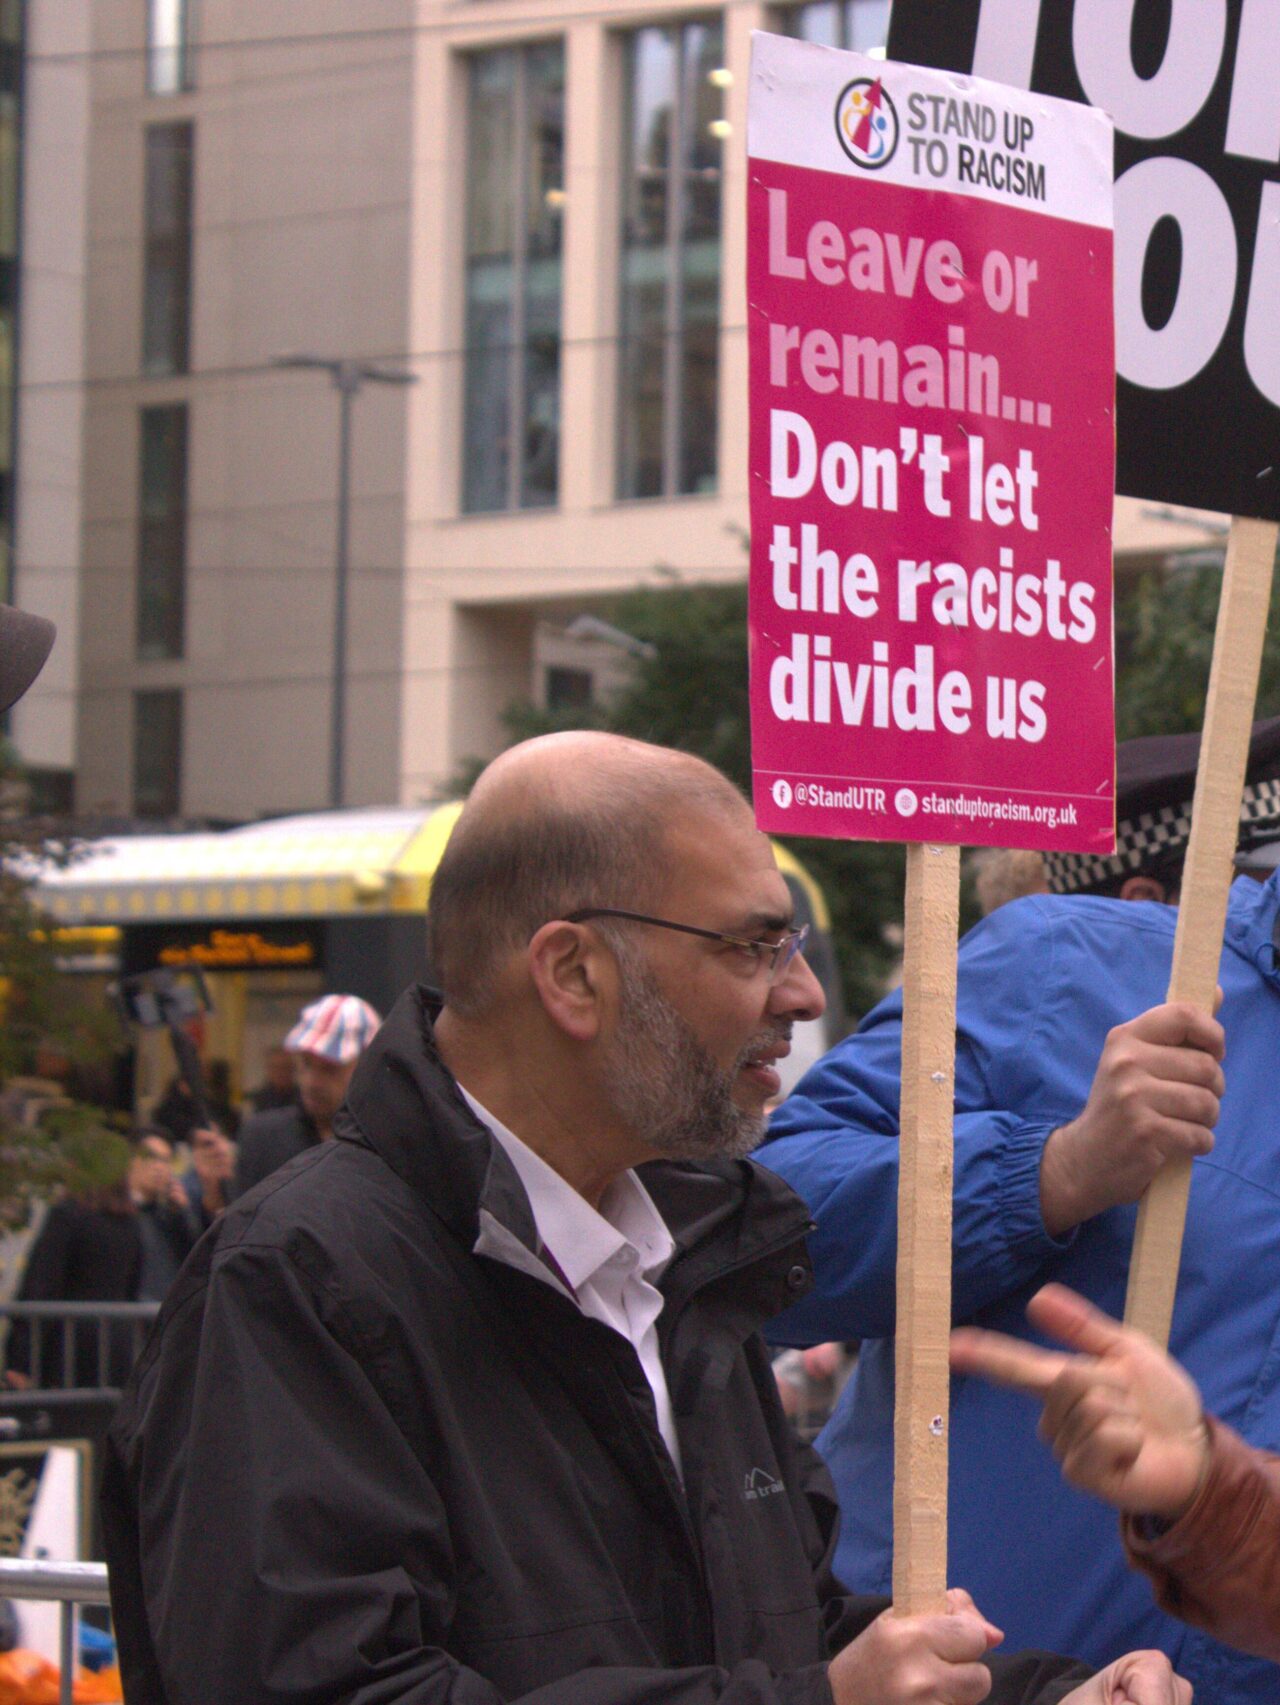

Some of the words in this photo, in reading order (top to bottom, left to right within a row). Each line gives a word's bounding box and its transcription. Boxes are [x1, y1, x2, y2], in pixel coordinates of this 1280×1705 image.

[907, 92, 996, 143] STAND
[1003, 113, 1034, 153] UP
[907, 136, 948, 178] TO
[957, 143, 1046, 201] RACISM
[768, 187, 966, 304] Leave
[981, 249, 1039, 319] or
[769, 322, 1052, 428] remain...
[968, 435, 1040, 532] let
[768, 522, 880, 619] the
[897, 547, 1097, 644] racists
[769, 632, 972, 735] divide
[986, 675, 1048, 743] us
[794, 781, 886, 811] @StandUTR
[921, 791, 1078, 829] standuptoracism.org.uk
